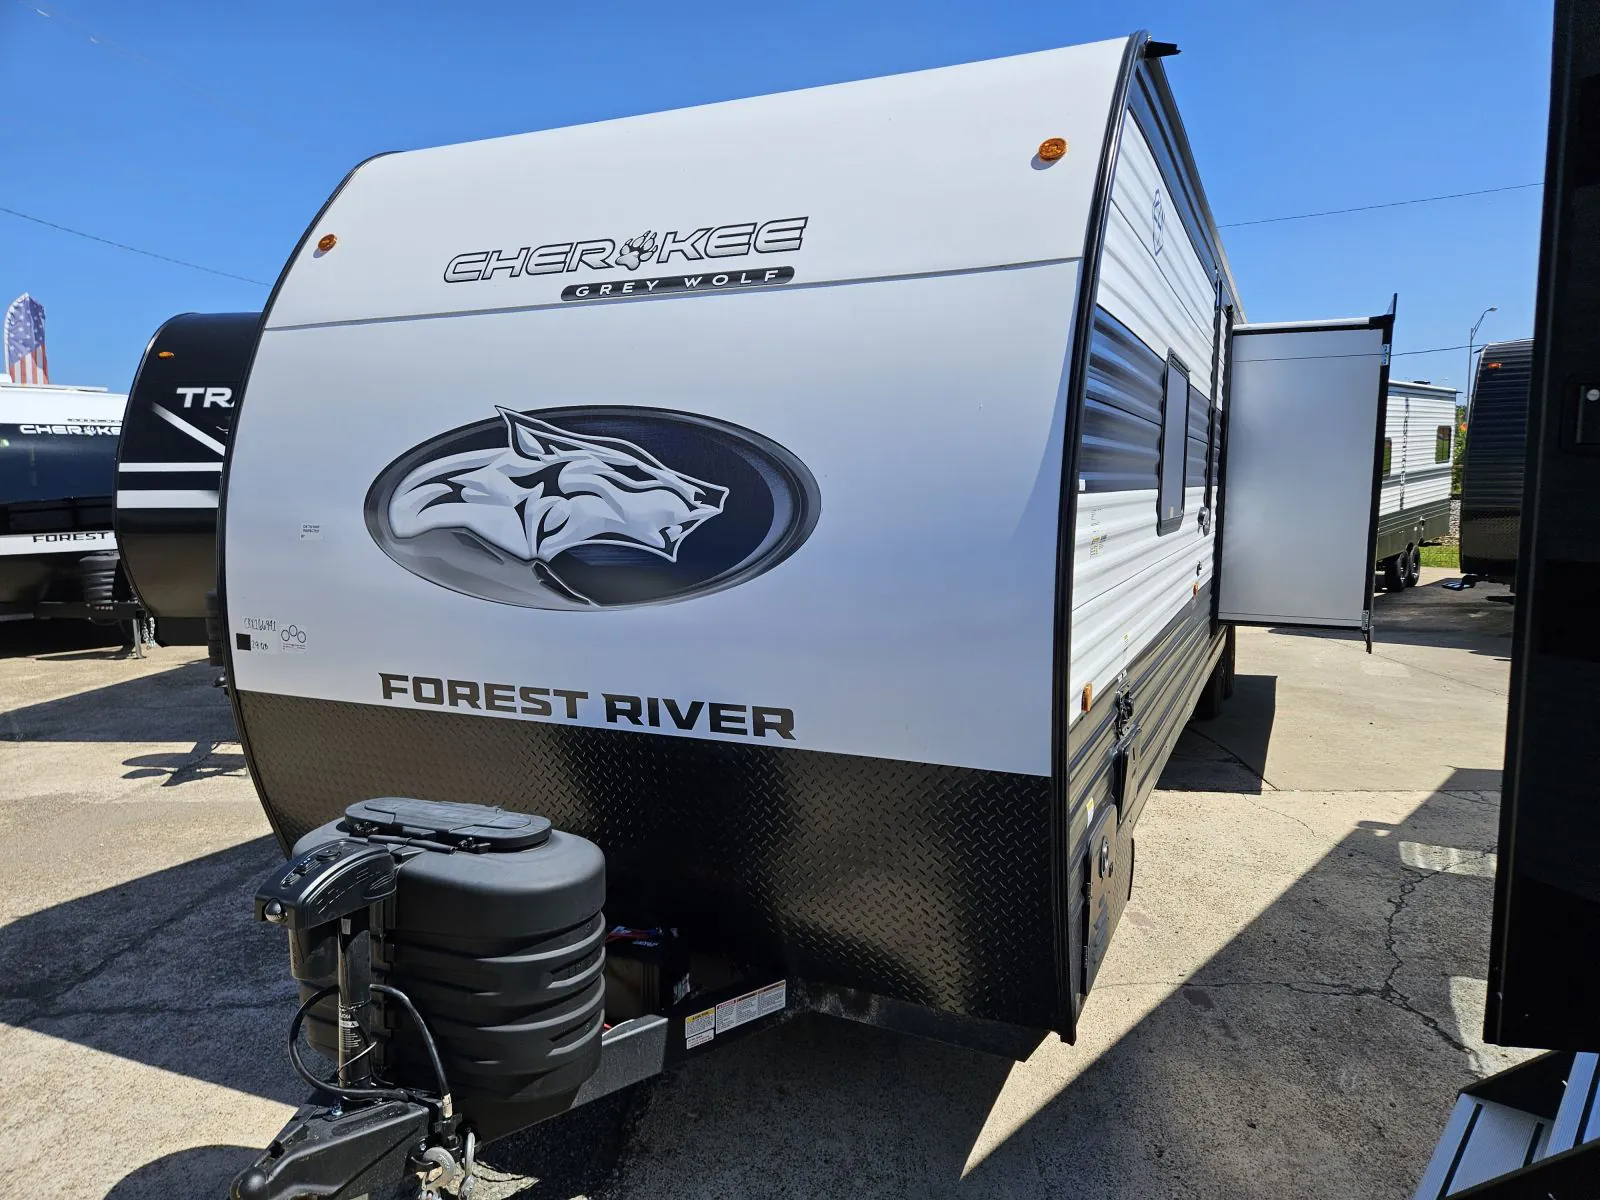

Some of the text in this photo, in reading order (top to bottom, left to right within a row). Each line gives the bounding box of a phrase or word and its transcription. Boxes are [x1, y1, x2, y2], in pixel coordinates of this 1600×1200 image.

[575, 269, 779, 298] GREY WOLF
[176, 387, 235, 408] TR
[32, 531, 110, 543] FOREST
[378, 672, 797, 741] FOREST RIVER
